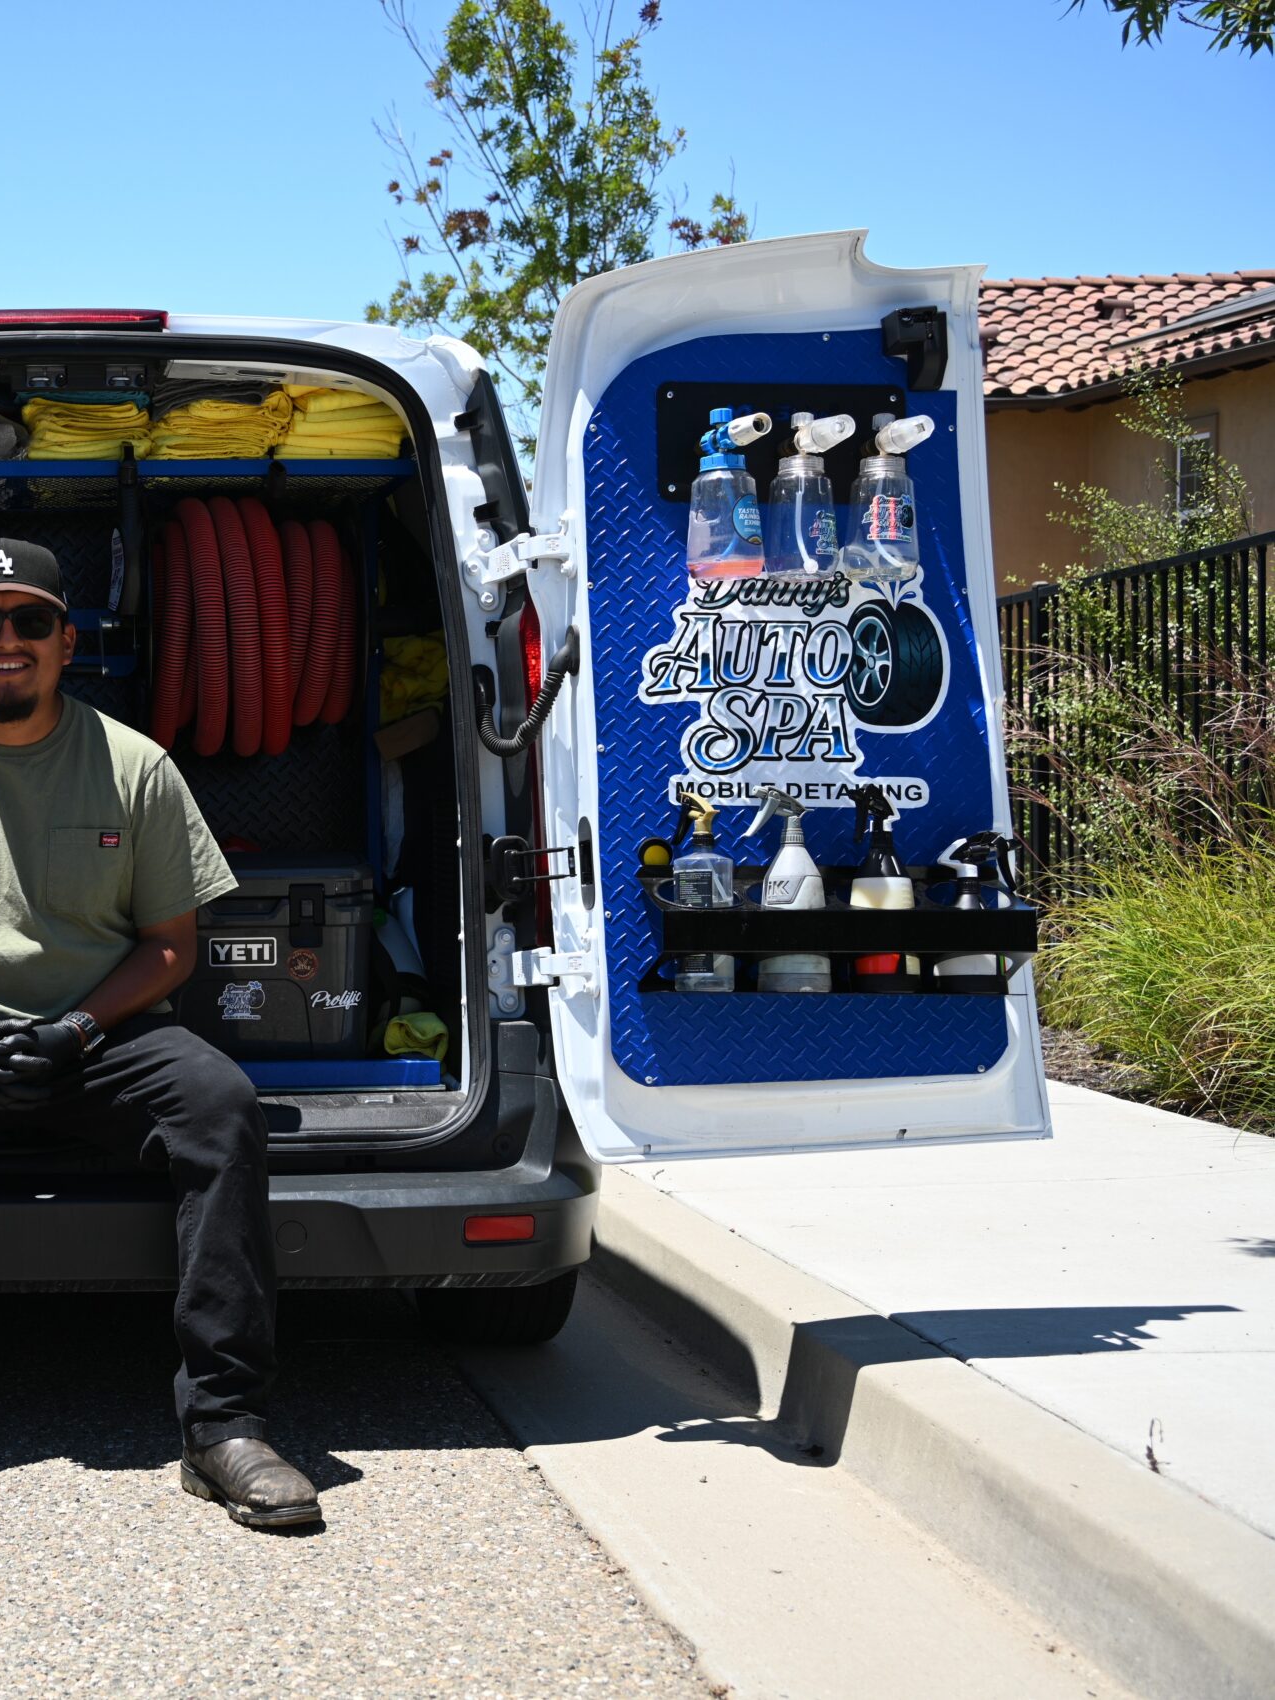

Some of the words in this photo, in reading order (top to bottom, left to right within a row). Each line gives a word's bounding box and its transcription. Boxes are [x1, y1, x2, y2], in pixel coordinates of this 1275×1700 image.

[694, 571, 852, 617] Danny's
[645, 612, 856, 696] AUTO
[687, 685, 856, 775] SPA
[213, 943, 270, 961] YETI
[310, 990, 363, 1010] Prolific
